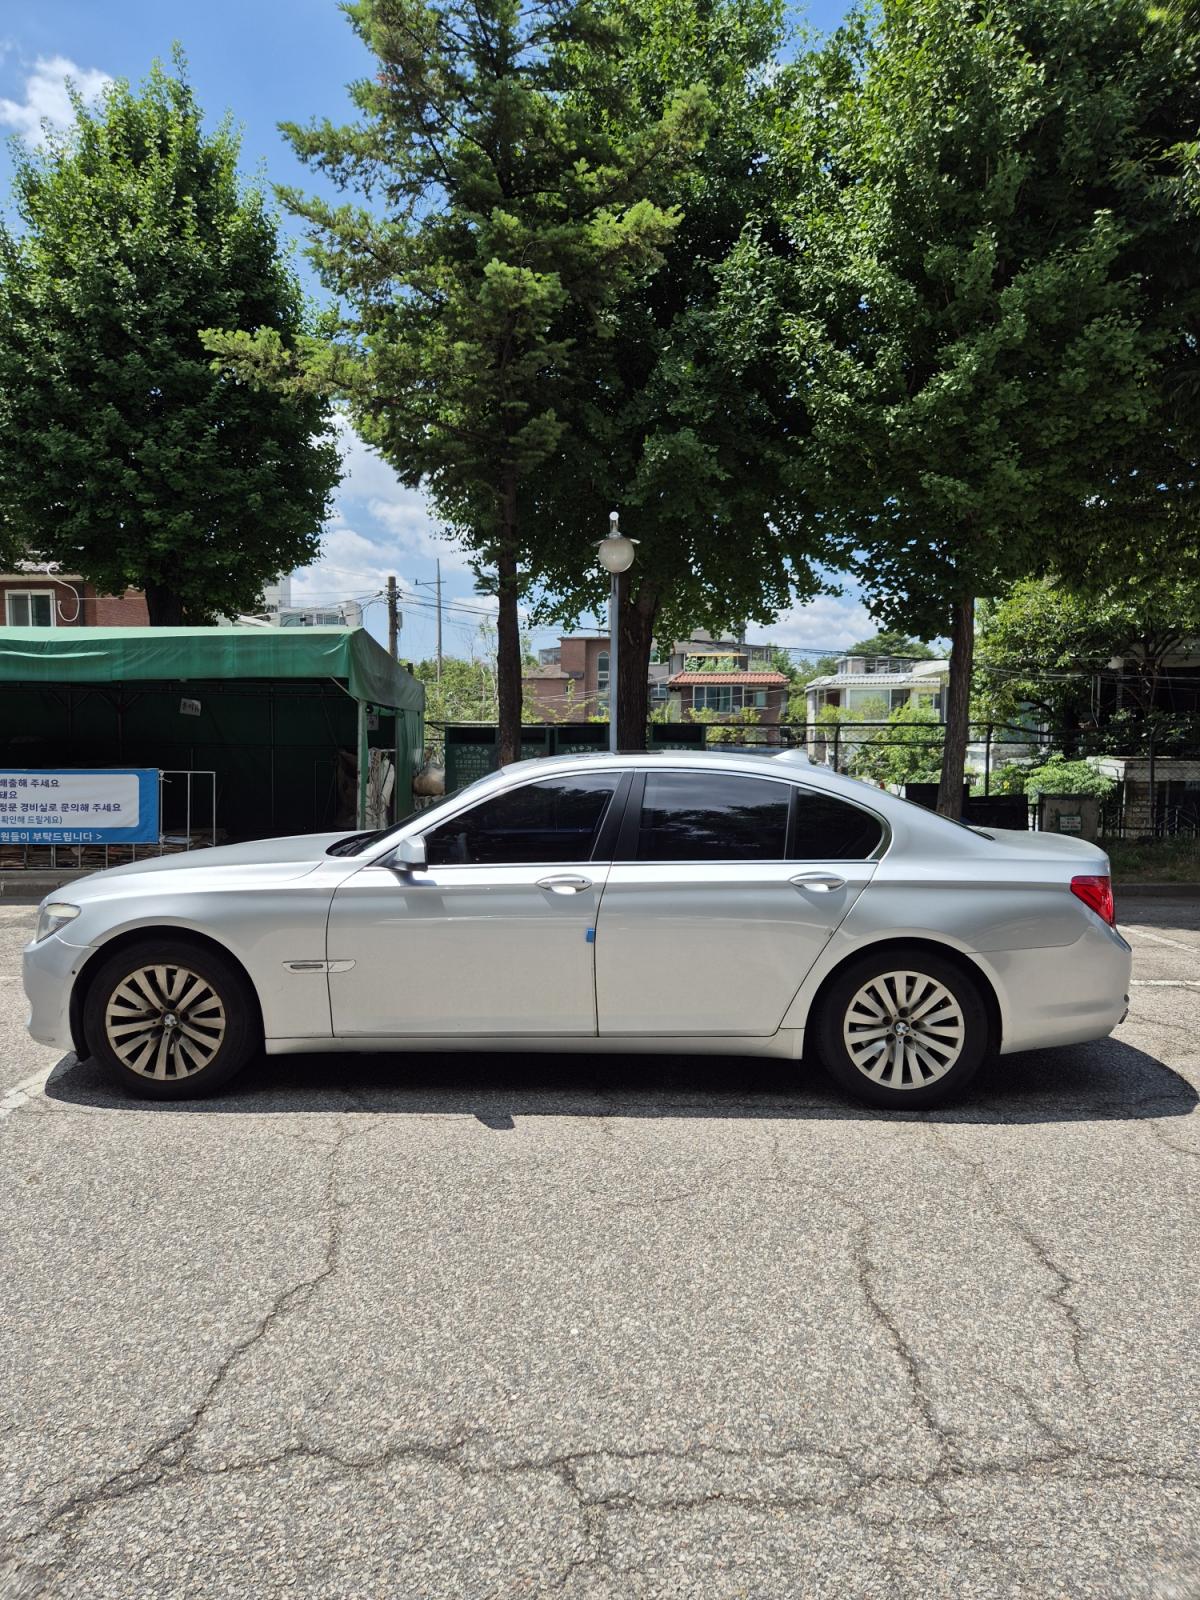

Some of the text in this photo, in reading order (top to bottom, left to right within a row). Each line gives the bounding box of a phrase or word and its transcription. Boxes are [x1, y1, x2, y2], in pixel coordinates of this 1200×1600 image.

[0, 778, 60, 788] 배출해 주세요
[0, 790, 18, 799] 돼요
[0, 803, 122, 812] 정문 경비실로 문의해 주세요
[1, 815, 63, 824] 확인해 드릴게요)
[1, 831, 30, 842] 원들이
[32, 831, 92, 842] 부탁드립니다
